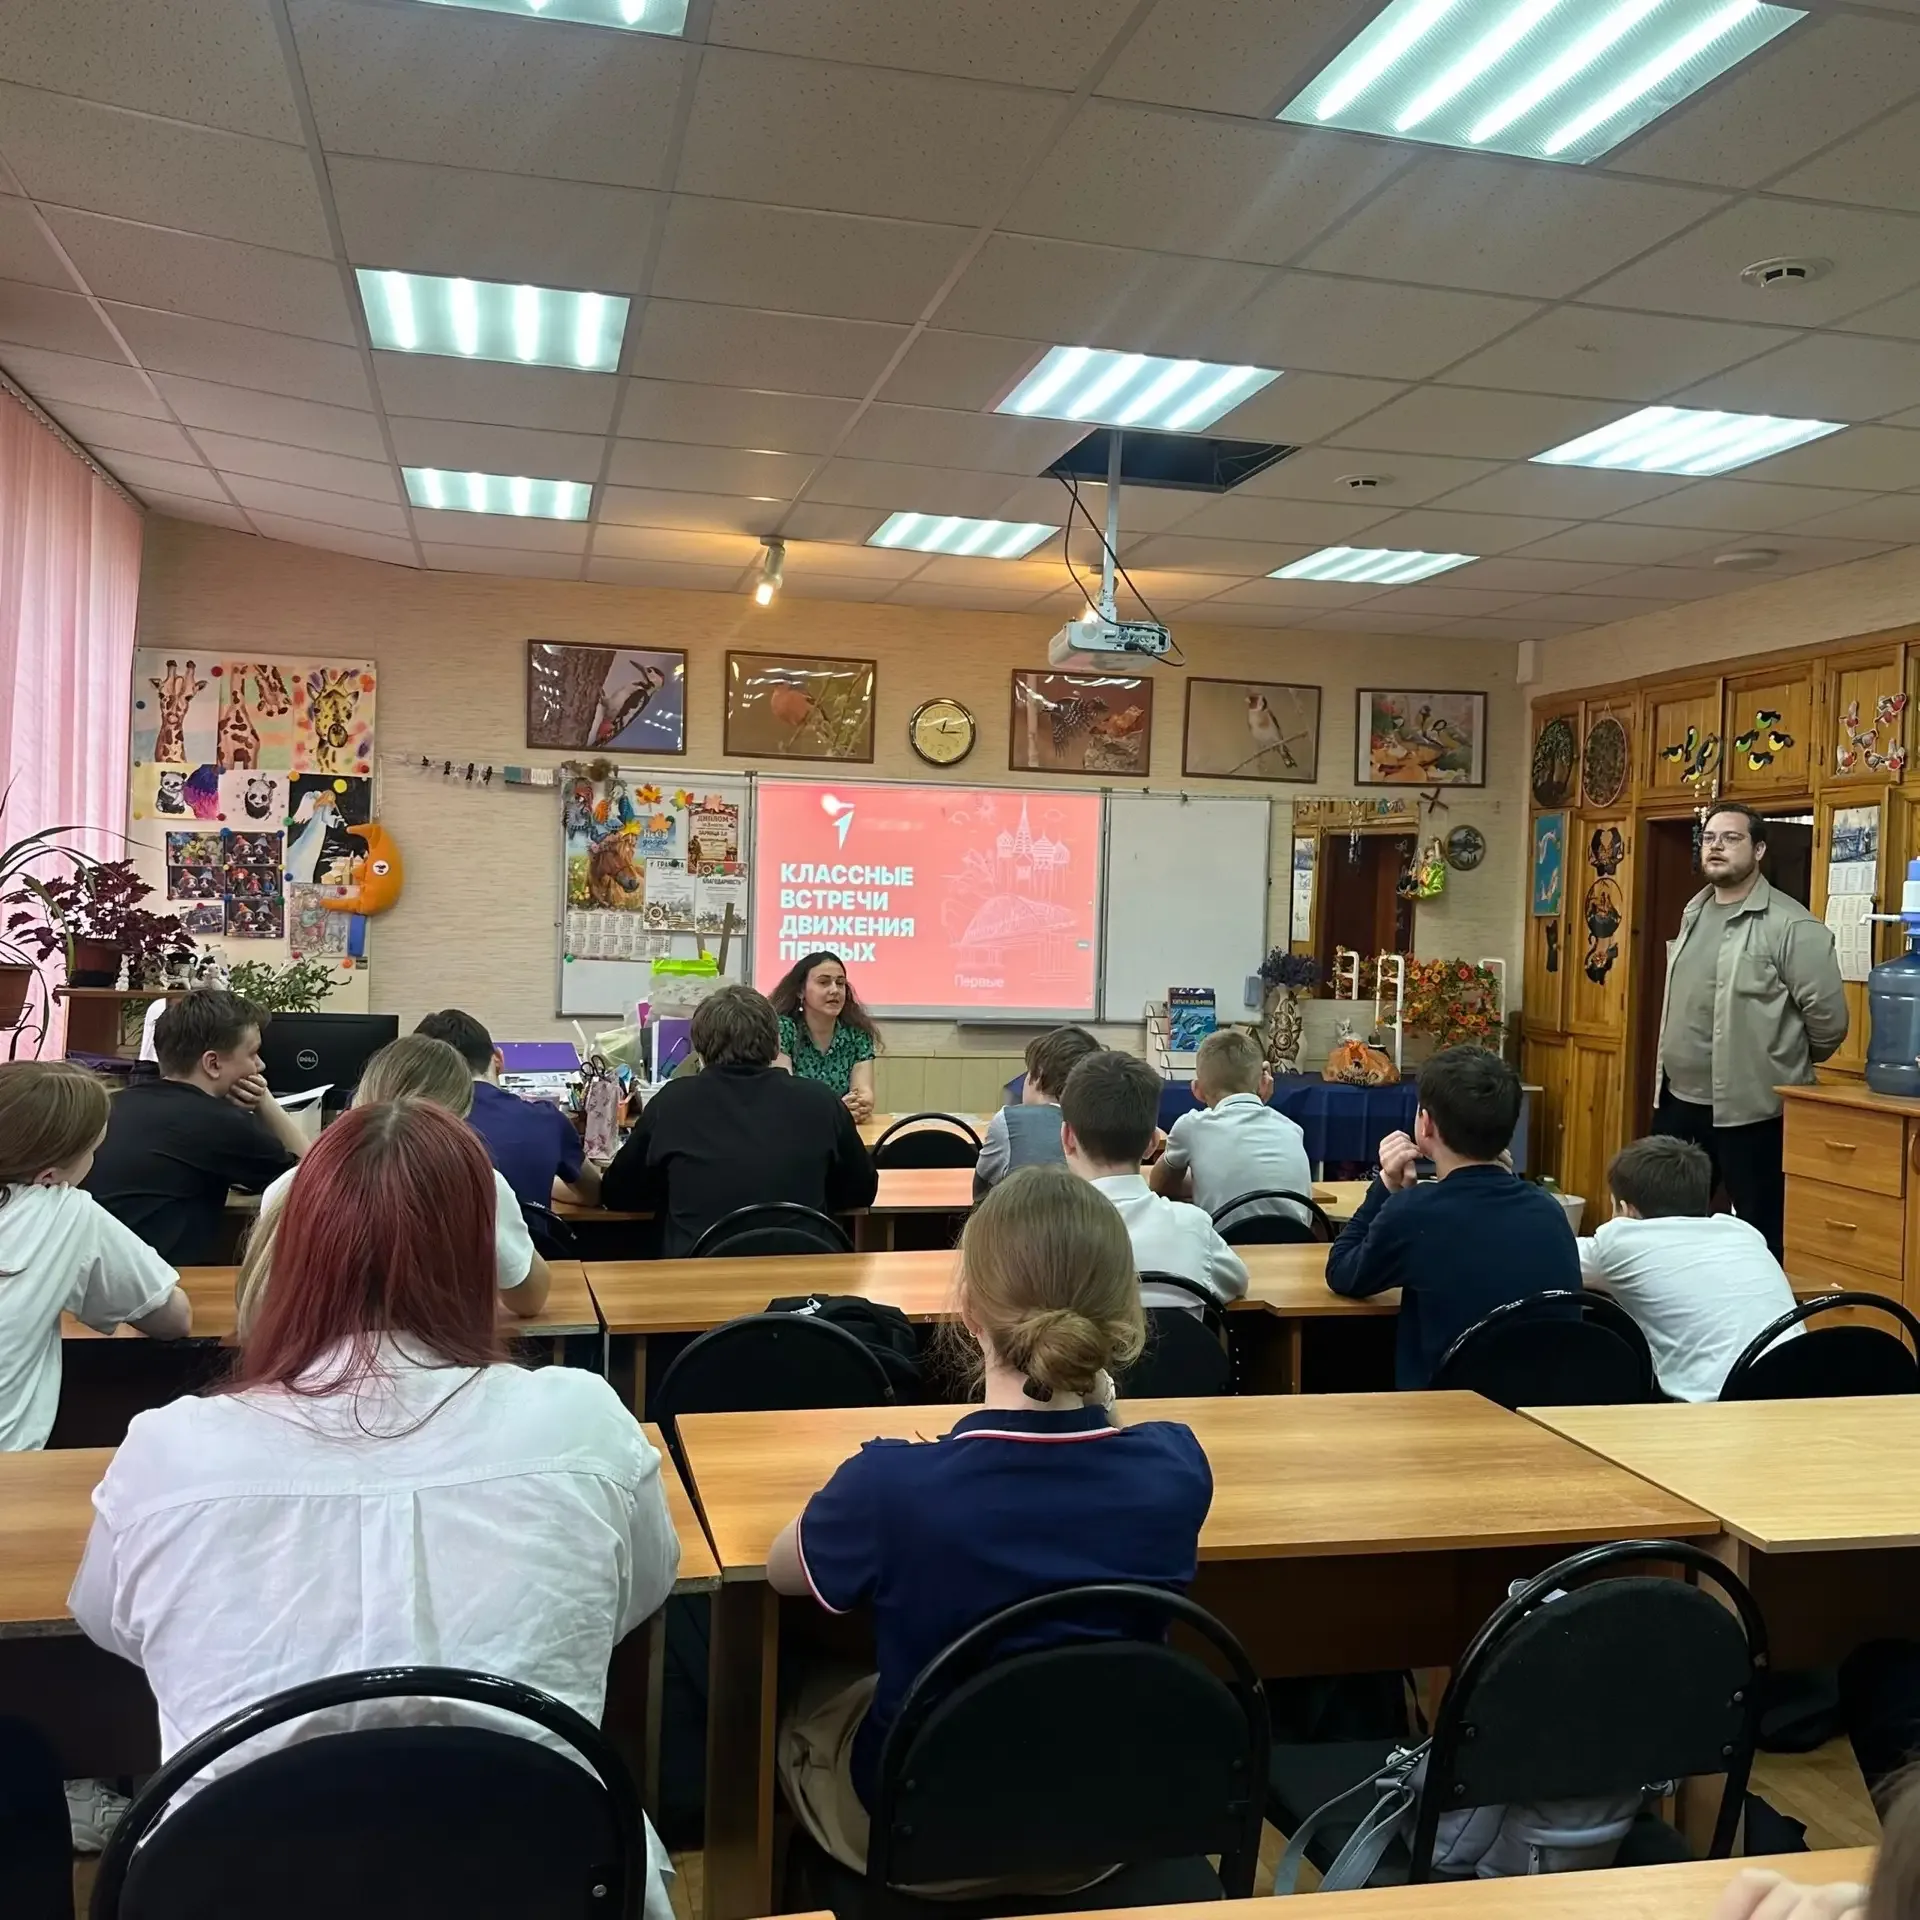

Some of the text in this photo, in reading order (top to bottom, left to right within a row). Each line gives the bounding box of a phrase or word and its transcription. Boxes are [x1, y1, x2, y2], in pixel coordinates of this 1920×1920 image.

[780, 863, 914, 886] КЛАССНЫЕ
[780, 889, 889, 911] ВСТРЕЧИ
[779, 915, 915, 938] ДВИЖЕНИЯ
[954, 974, 1005, 989] Первые
